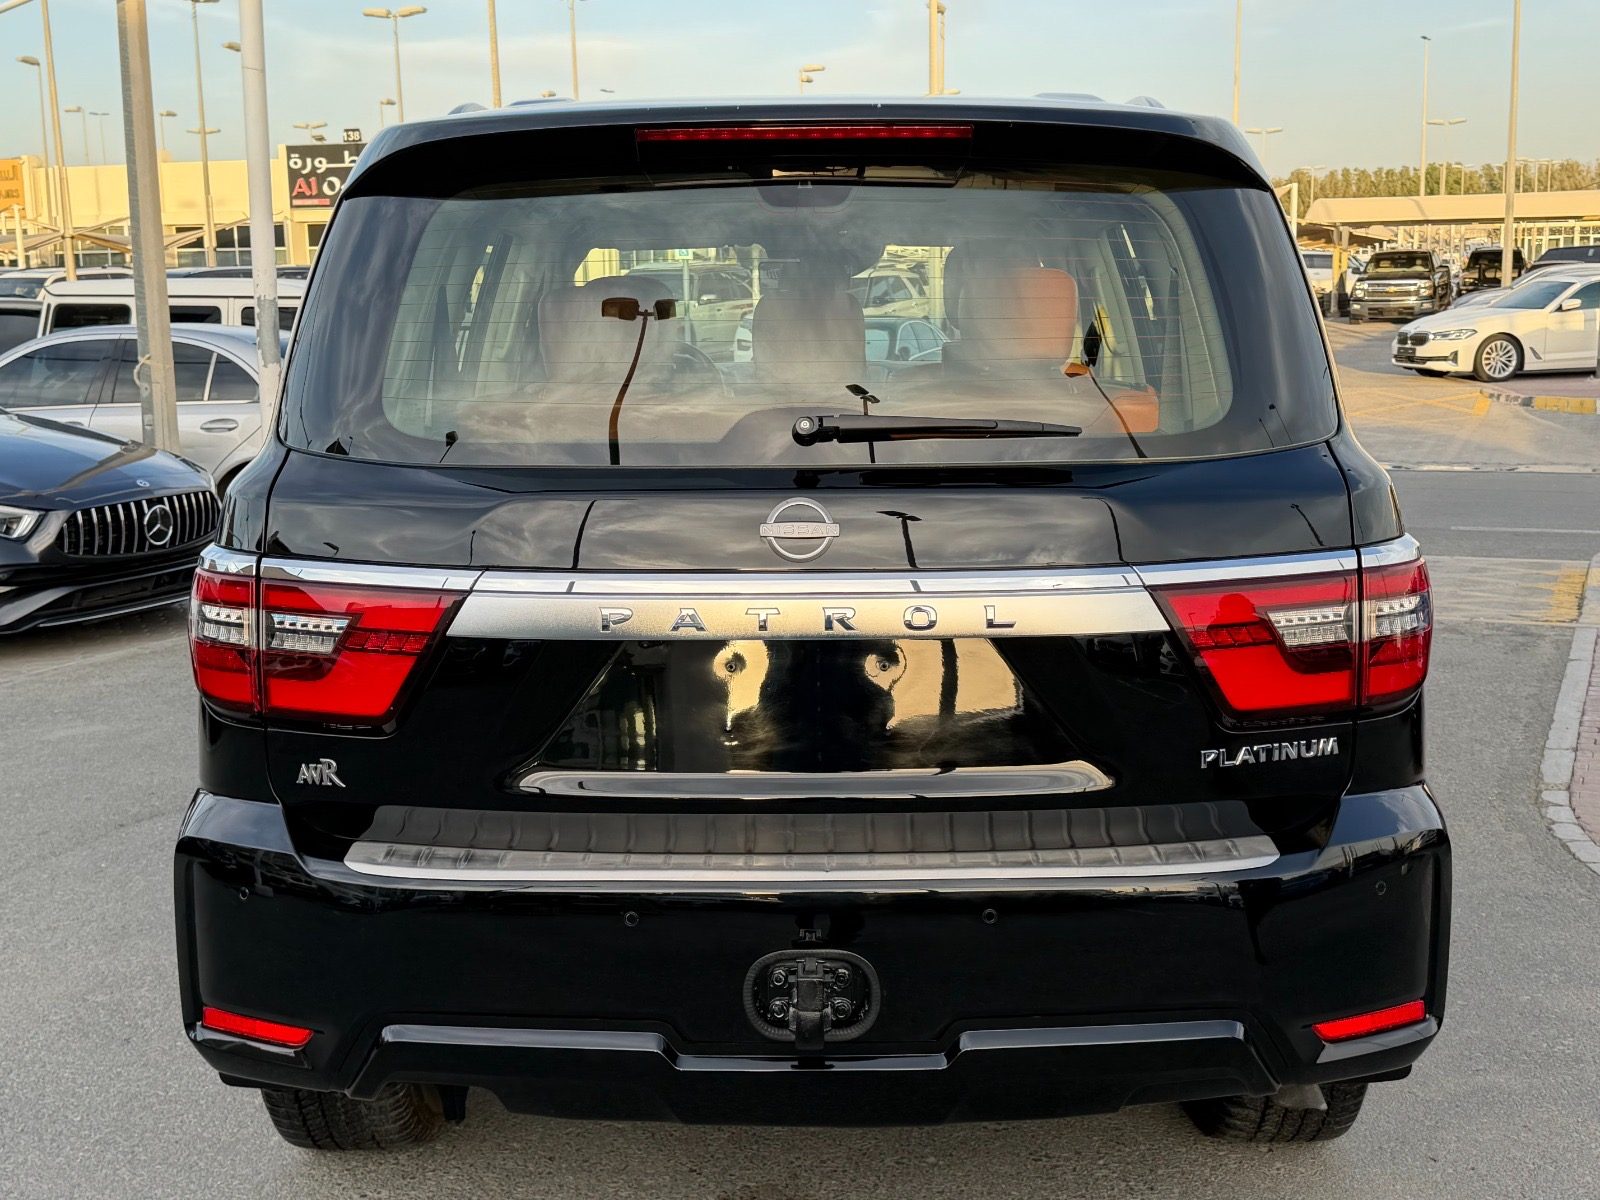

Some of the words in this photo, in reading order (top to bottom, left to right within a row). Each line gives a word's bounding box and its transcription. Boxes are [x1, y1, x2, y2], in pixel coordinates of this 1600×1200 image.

[343, 131, 360, 141] 138
[289, 150, 359, 174] طورة
[292, 176, 318, 196] Al
[322, 176, 345, 196] O
[761, 523, 838, 536] NISSAN
[599, 605, 1017, 632] PATROL
[1200, 737, 1339, 769] PLATINUM
